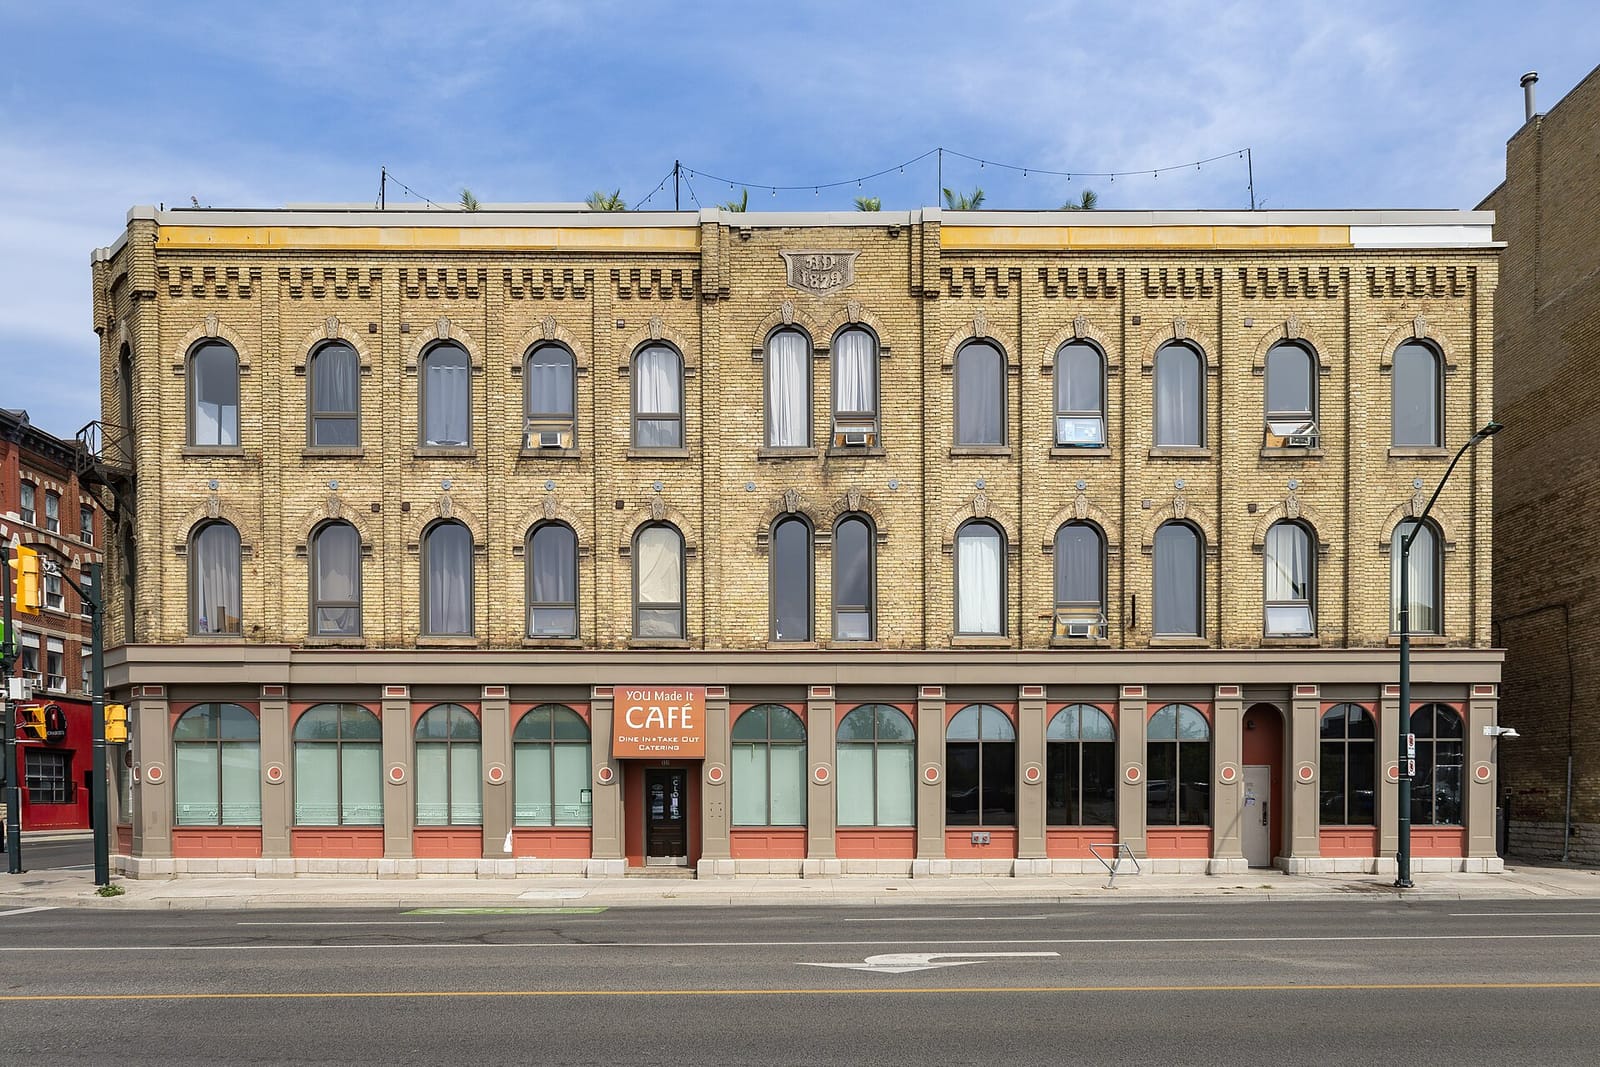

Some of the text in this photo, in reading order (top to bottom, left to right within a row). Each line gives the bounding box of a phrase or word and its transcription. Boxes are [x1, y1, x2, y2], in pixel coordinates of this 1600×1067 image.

[626, 691, 694, 701] YOU Made It
[625, 703, 693, 729] CAFÉ
